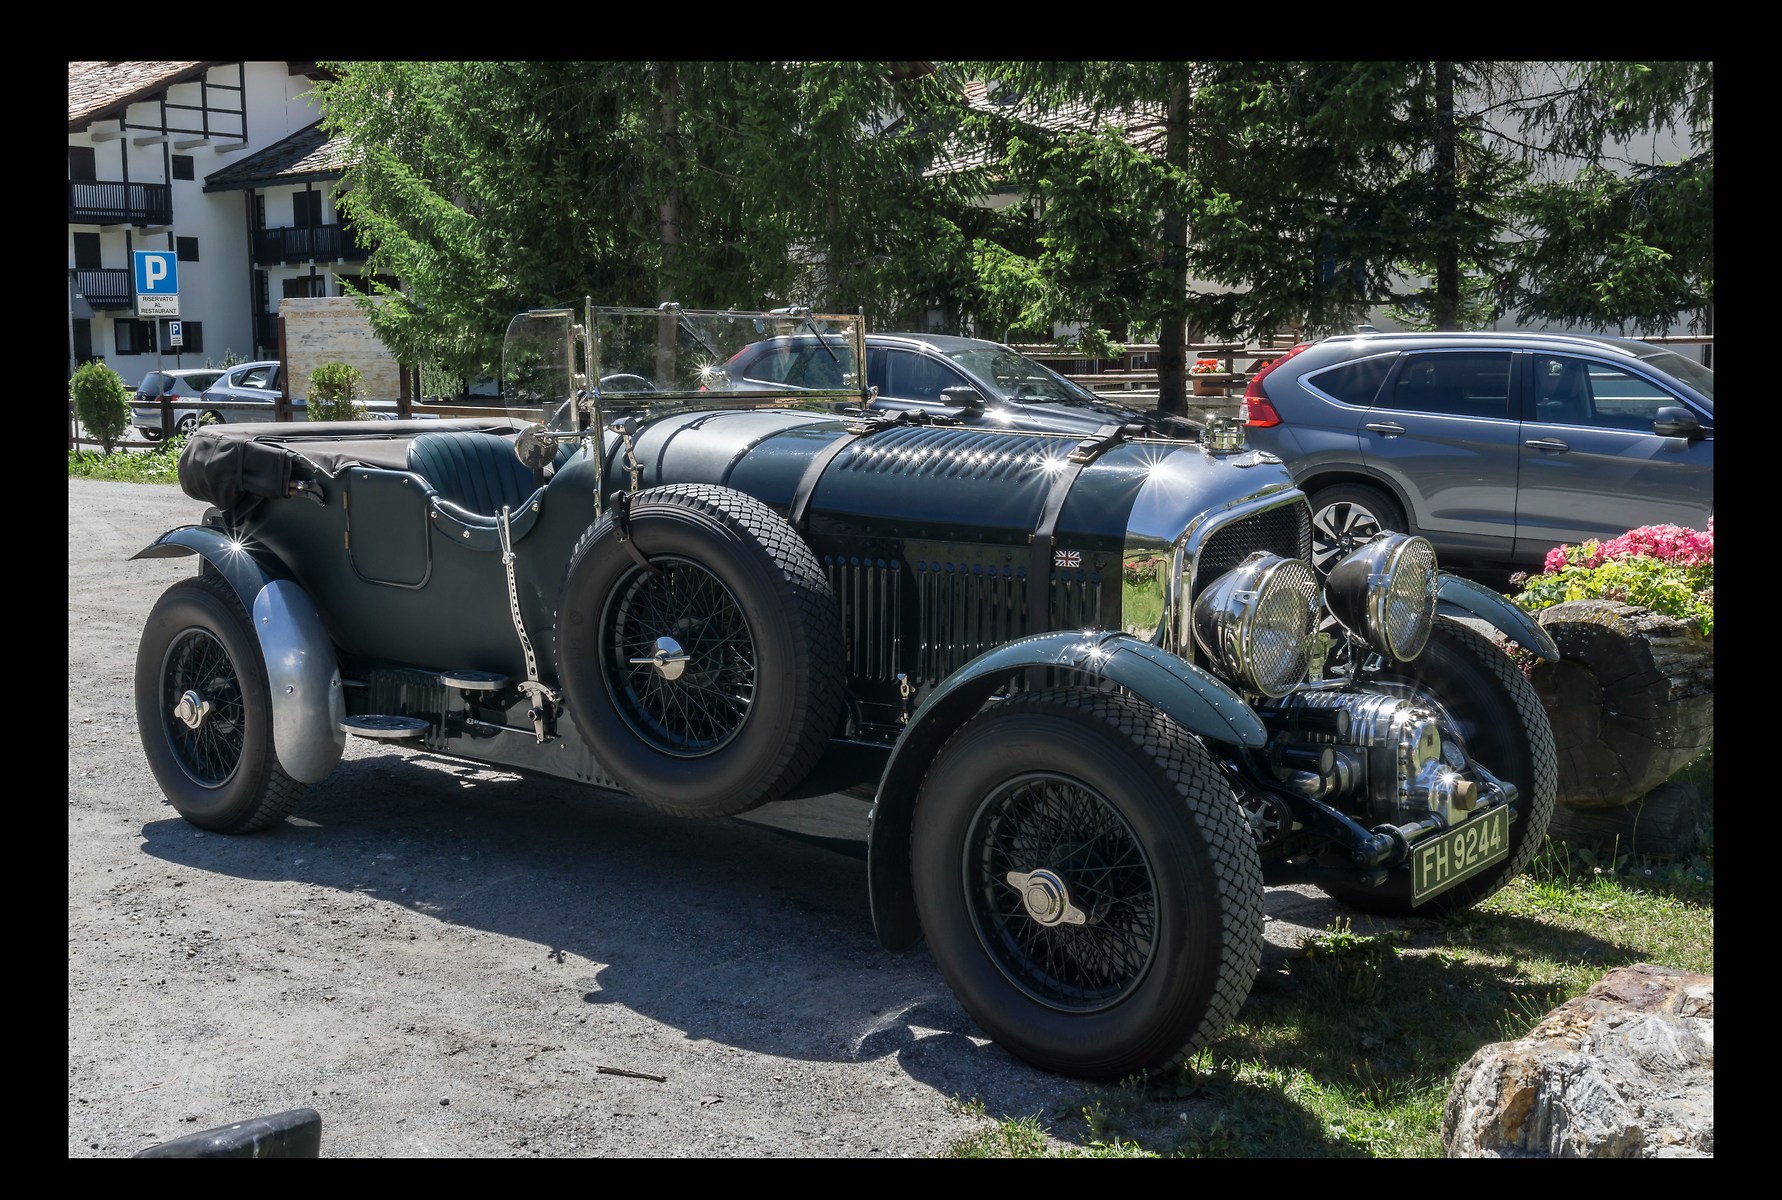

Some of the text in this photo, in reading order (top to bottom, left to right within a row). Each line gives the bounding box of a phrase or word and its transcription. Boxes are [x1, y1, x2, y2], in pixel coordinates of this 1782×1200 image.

[145, 255, 167, 289] P
[172, 324, 179, 334] P
[1422, 815, 1501, 888] FH 9244
